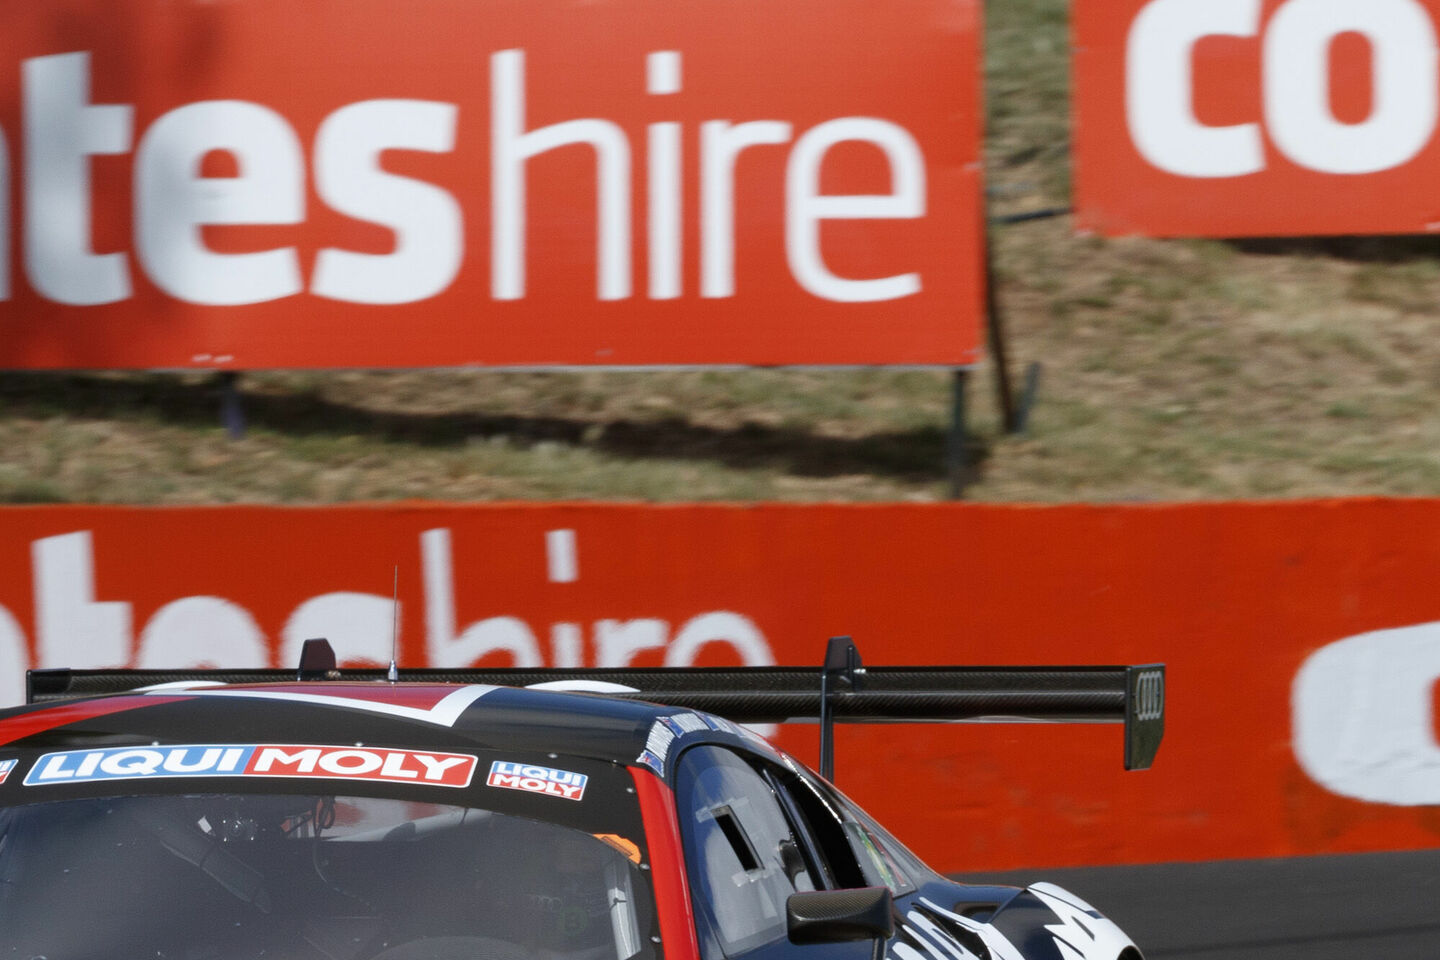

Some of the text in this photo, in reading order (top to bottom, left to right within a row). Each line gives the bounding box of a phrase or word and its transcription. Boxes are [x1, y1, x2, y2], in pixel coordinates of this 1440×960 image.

[38, 748, 469, 781] LIQUI MOLY
[496, 762, 582, 787] LIQUI
[491, 773, 582, 798] MOLY
